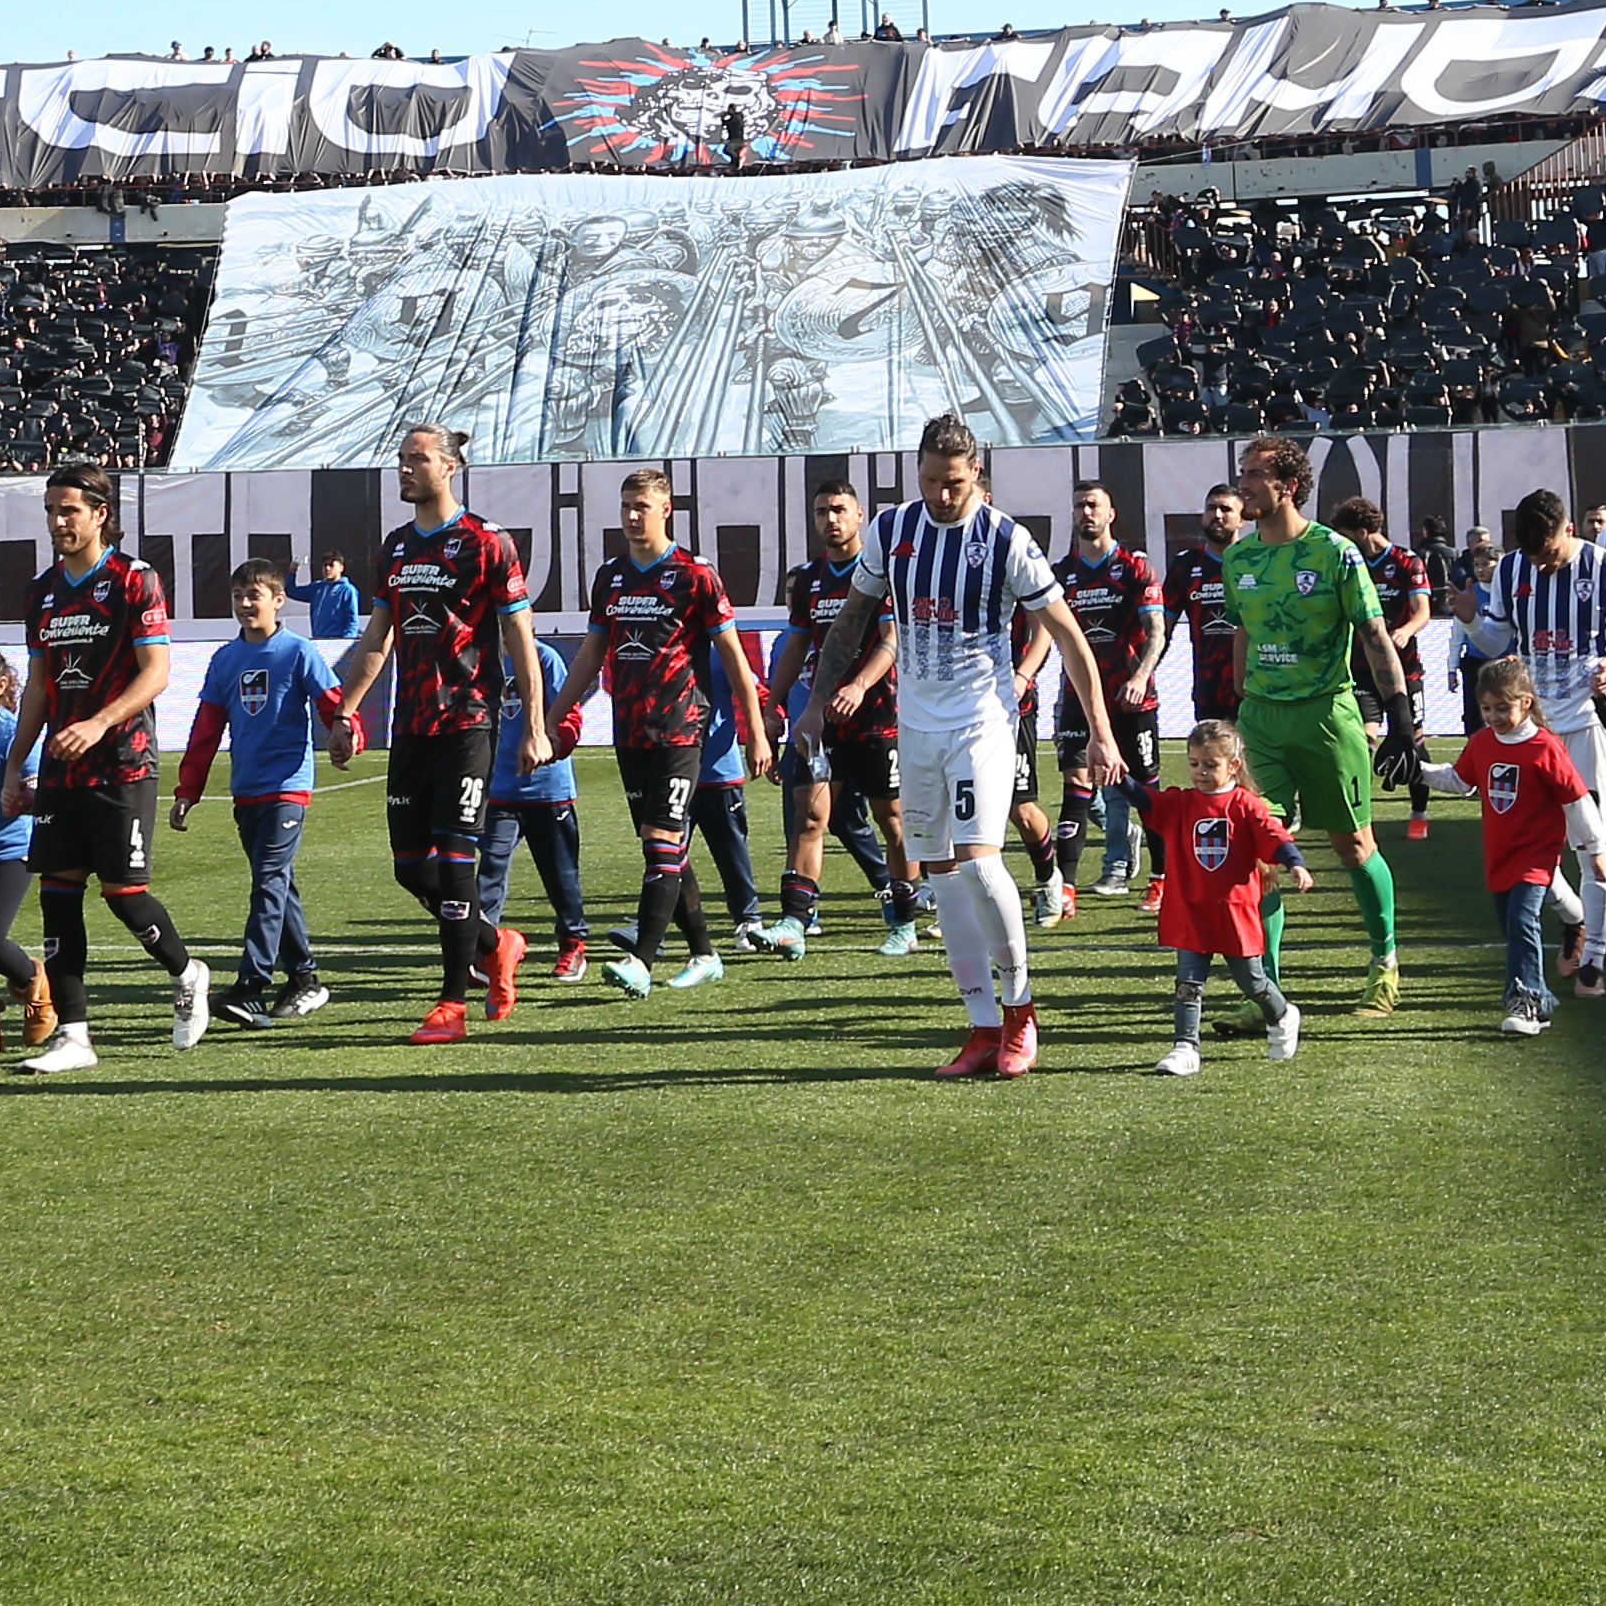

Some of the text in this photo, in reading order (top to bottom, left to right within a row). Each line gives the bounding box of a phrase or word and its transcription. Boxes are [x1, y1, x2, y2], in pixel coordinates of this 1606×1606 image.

[618, 595, 658, 606] SUPER
[50, 614, 91, 629] SUPER
[459, 776, 484, 809] 26
[669, 777, 692, 806] 27
[954, 779, 976, 821] 5
